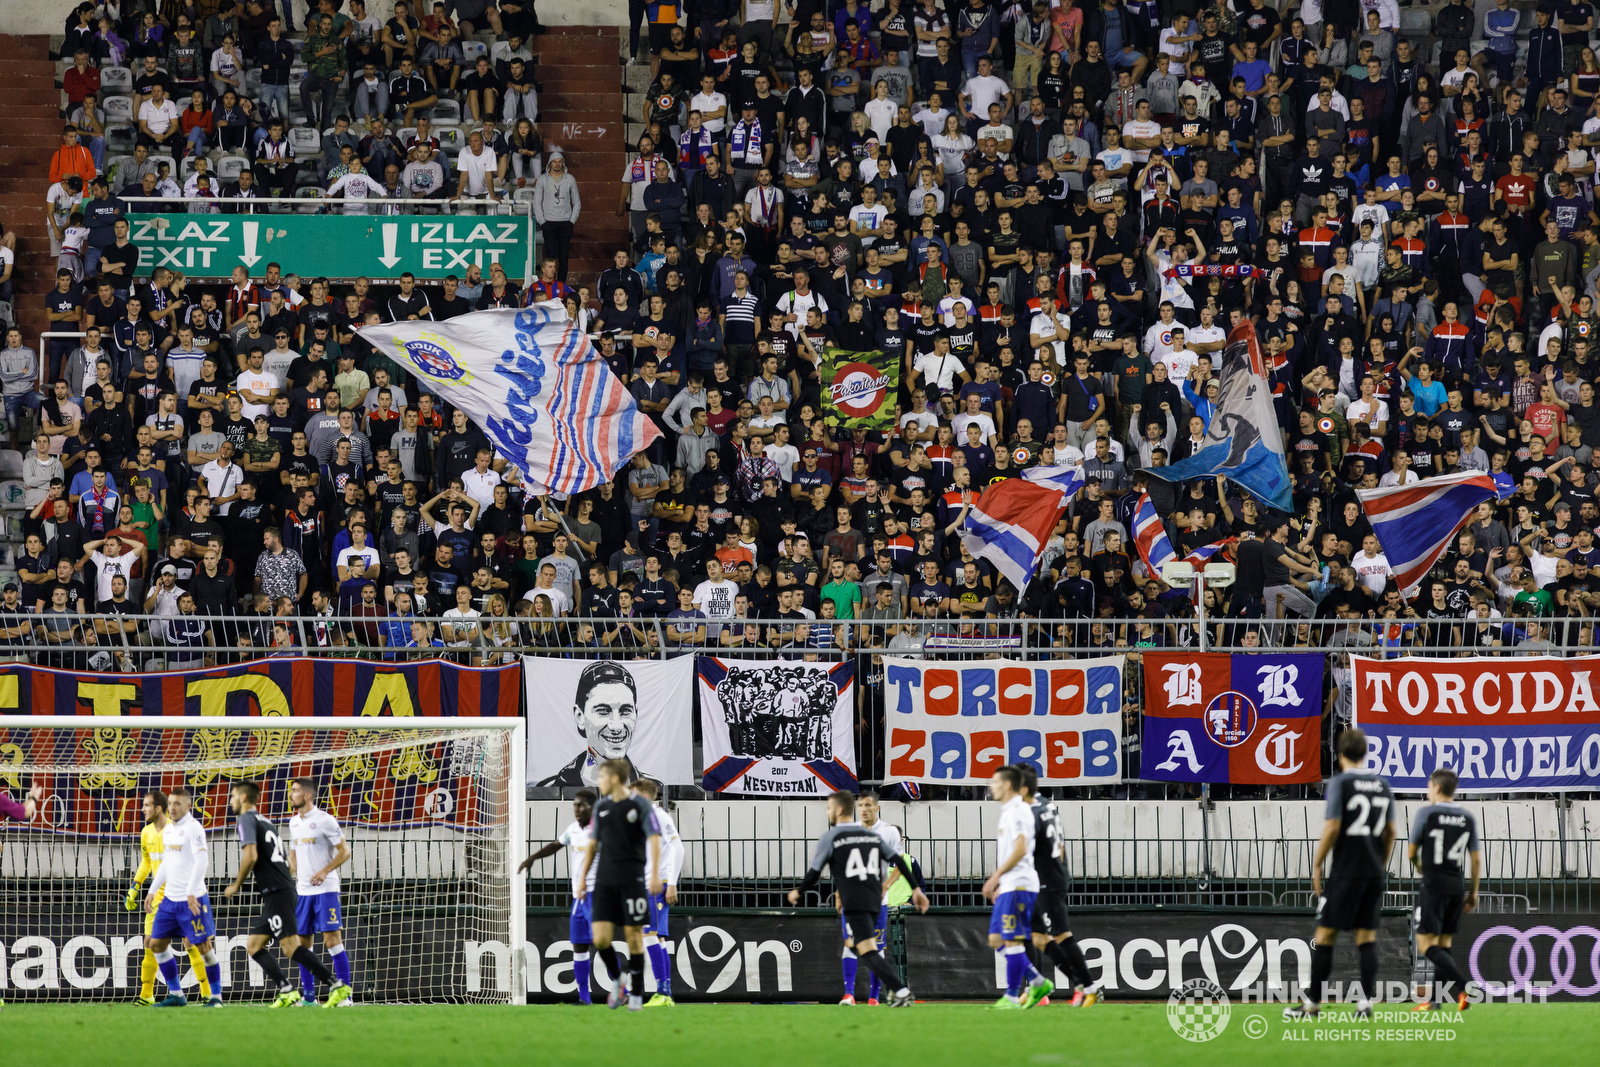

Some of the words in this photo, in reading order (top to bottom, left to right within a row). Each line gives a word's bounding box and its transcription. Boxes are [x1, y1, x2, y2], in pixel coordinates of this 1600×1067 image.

[410, 222, 518, 243] IZLAZ
[137, 246, 218, 268] EXIT
[423, 248, 506, 270] EXIT
[955, 254, 974, 271] 89
[950, 332, 974, 348] EVERLAST
[1092, 328, 1116, 338] NIKE
[946, 638, 984, 647] HAJDUK
[887, 664, 1121, 717] TORCIDA
[1161, 662, 1202, 709] B
[1256, 664, 1304, 708] R
[1366, 670, 1600, 716] TORCIDA
[890, 728, 1118, 780] ZAGREB
[1154, 729, 1204, 774] A
[772, 767, 788, 776] 2017
[742, 774, 818, 793] NESVRSTANI
[1346, 794, 1391, 837] 27
[1429, 828, 1471, 867] 14
[845, 848, 881, 881] 44
[329, 908, 337, 922] 3
[626, 898, 648, 915] 10
[191, 920, 205, 932] 14
[1002, 914, 1016, 930] 50
